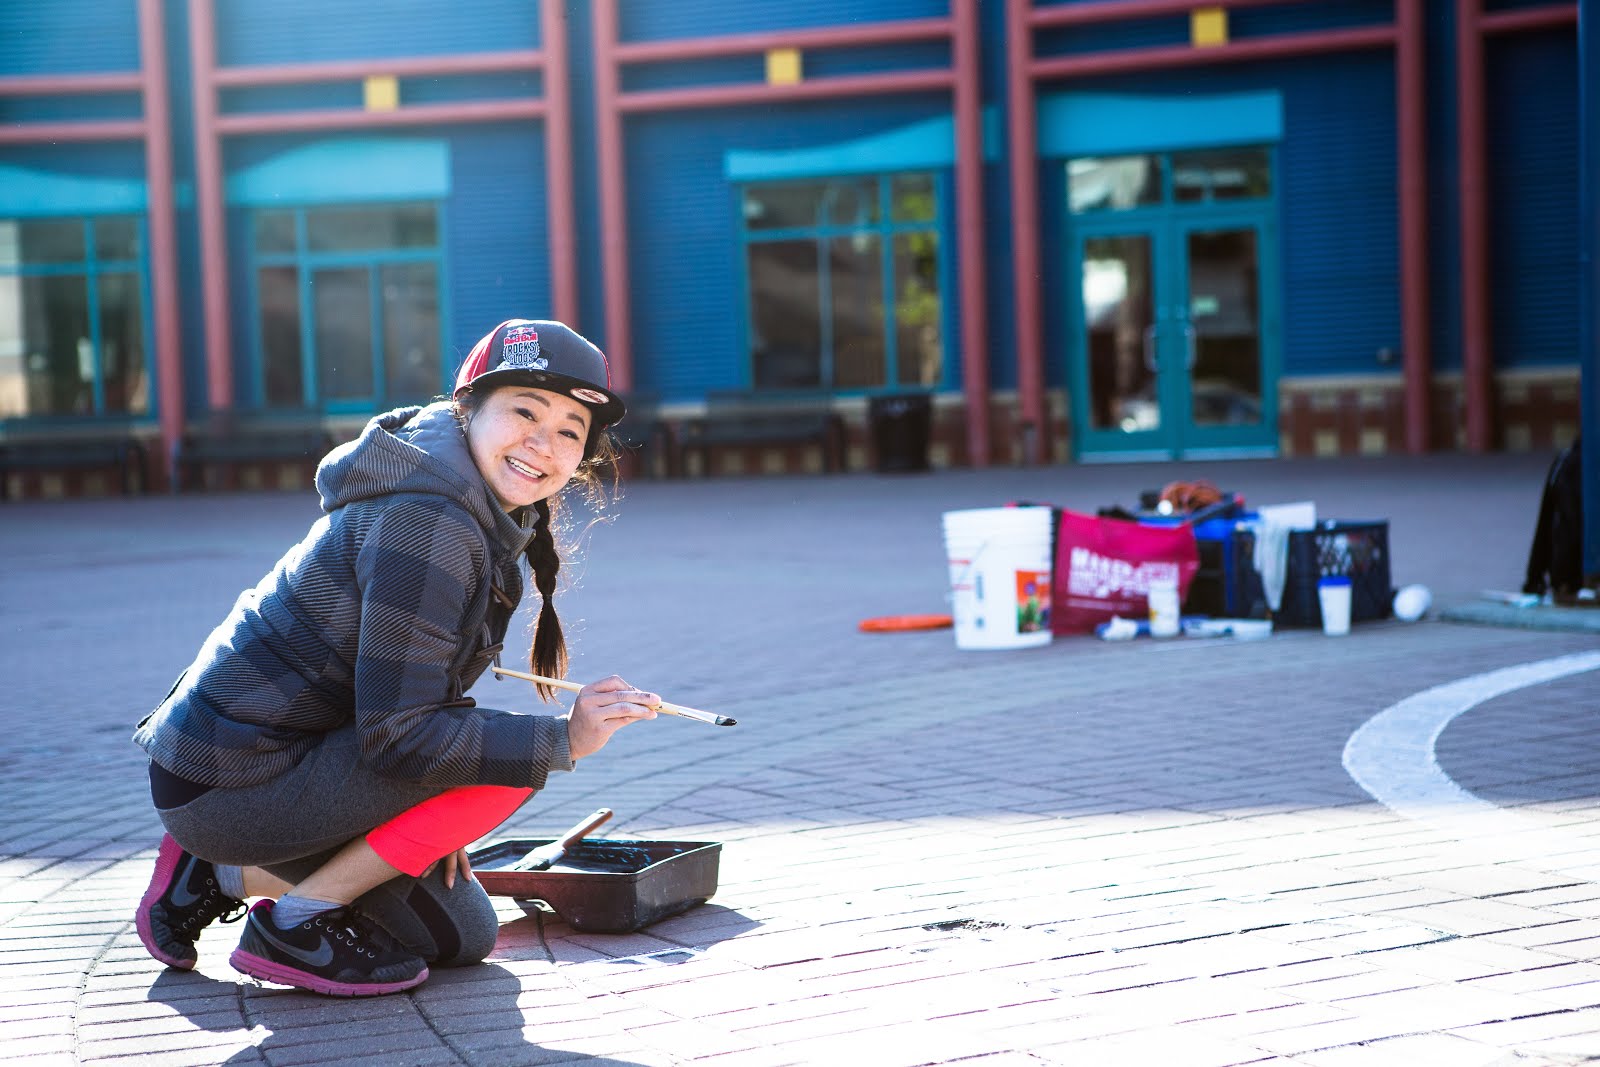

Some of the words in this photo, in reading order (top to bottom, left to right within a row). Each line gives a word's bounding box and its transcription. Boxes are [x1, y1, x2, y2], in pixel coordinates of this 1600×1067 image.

[504, 335, 521, 346] Red
[521, 332, 538, 343] Bull
[507, 342, 535, 354] ROCKS
